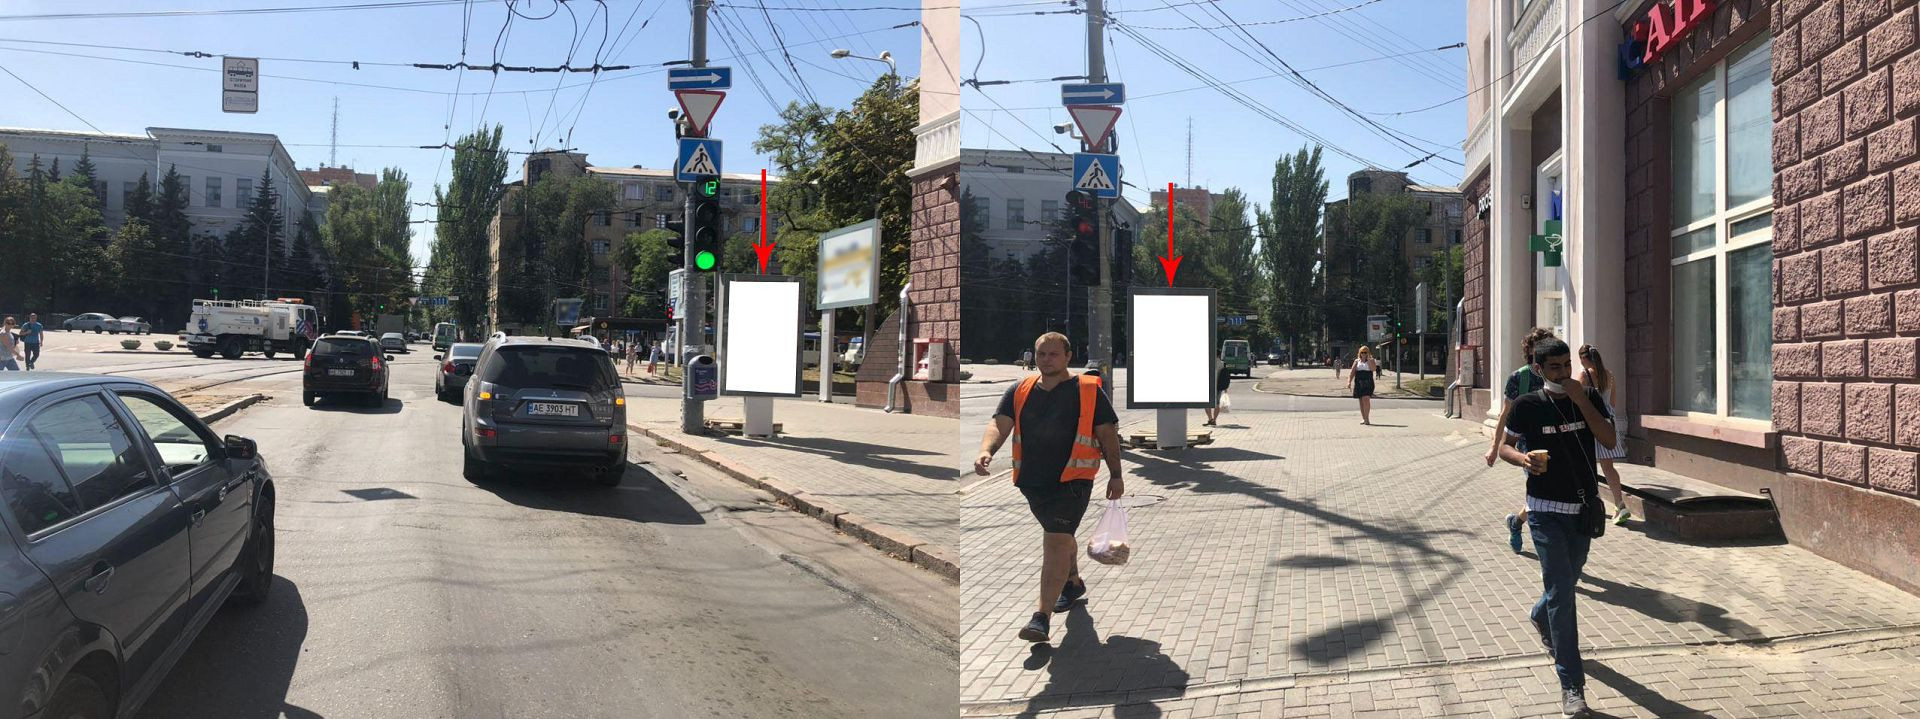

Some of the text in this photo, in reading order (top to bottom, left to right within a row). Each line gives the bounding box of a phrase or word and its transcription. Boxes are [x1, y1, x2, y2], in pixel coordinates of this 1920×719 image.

[705, 181, 716, 195] 12
[534, 403, 576, 414] AE 3903 HT
